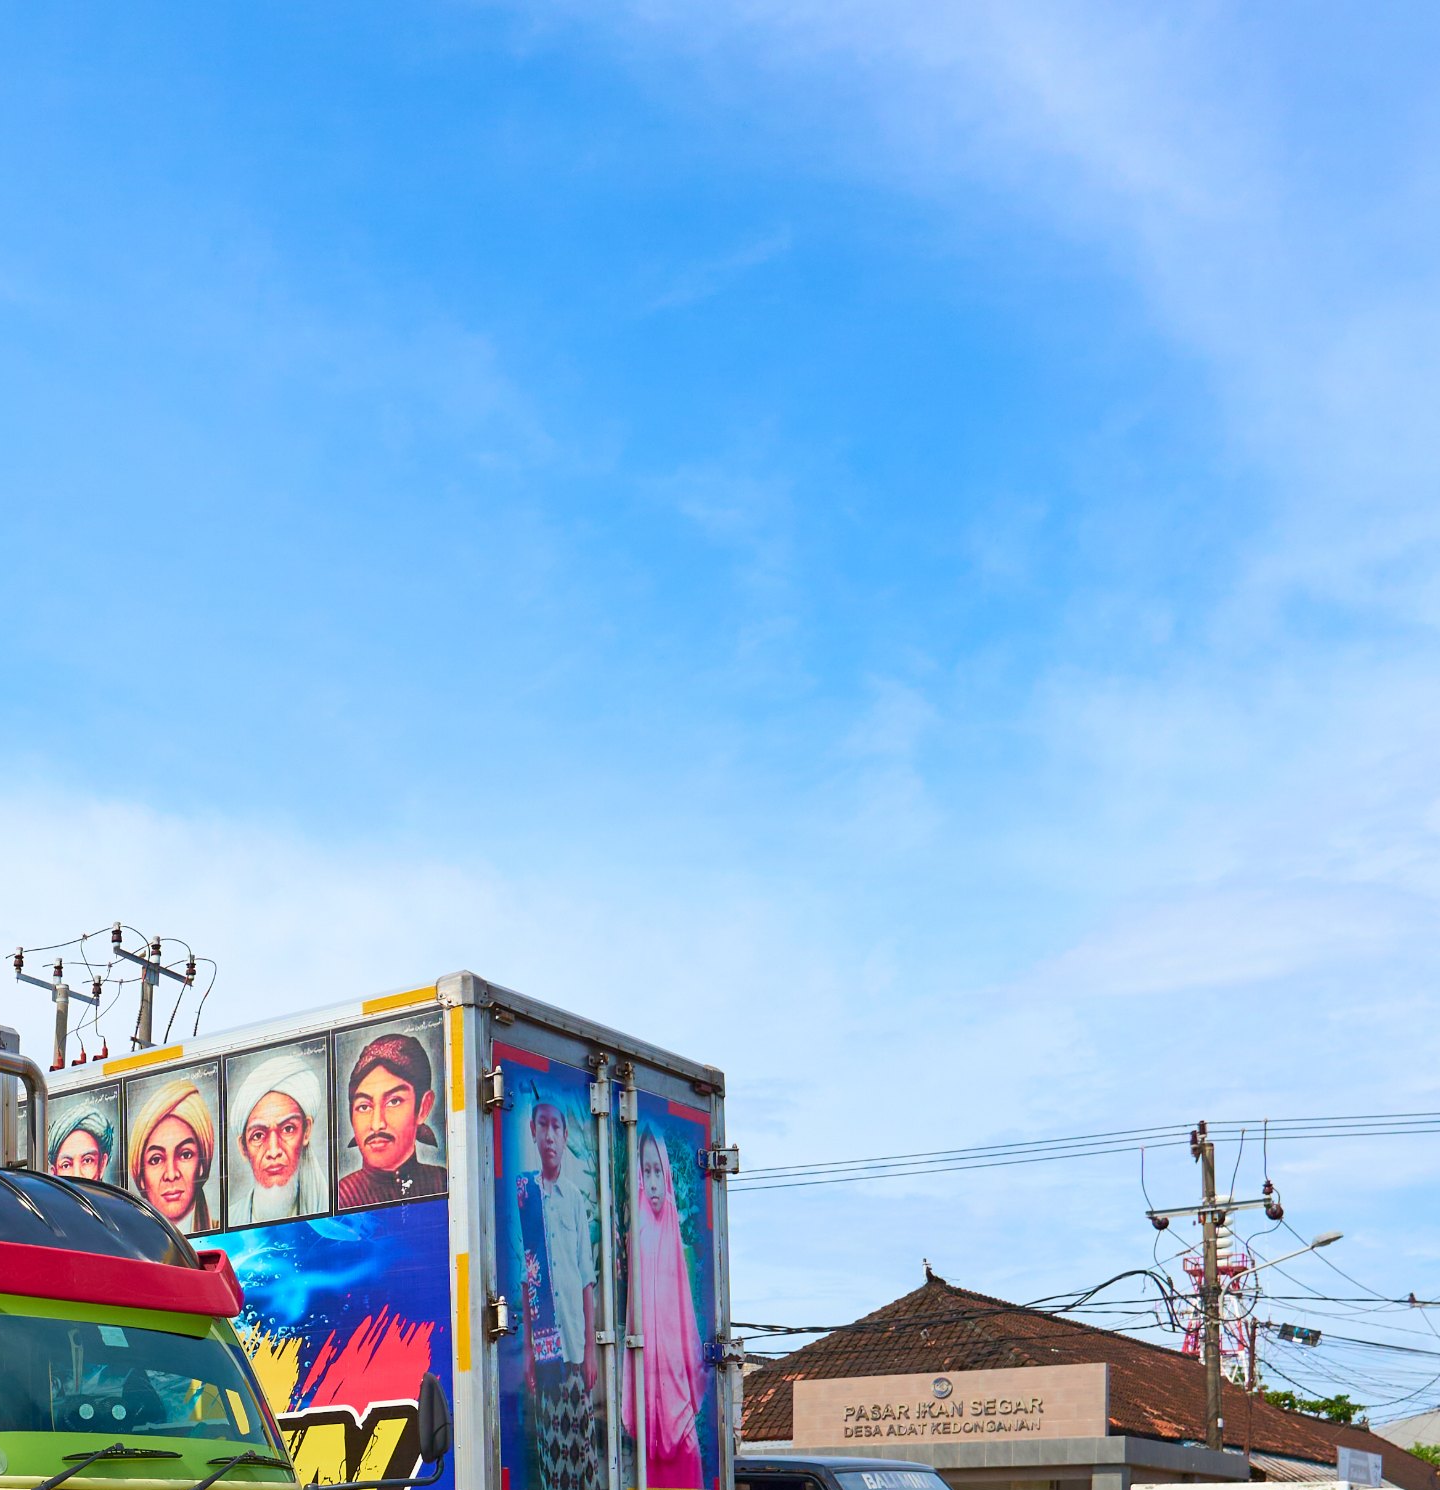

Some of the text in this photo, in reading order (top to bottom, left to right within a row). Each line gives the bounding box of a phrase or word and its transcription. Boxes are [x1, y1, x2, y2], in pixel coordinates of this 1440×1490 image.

[844, 1397, 1044, 1422] PASAR IKAN SEGAR
[844, 1417, 1041, 1438] DESA ADAT KEDONGANAN
